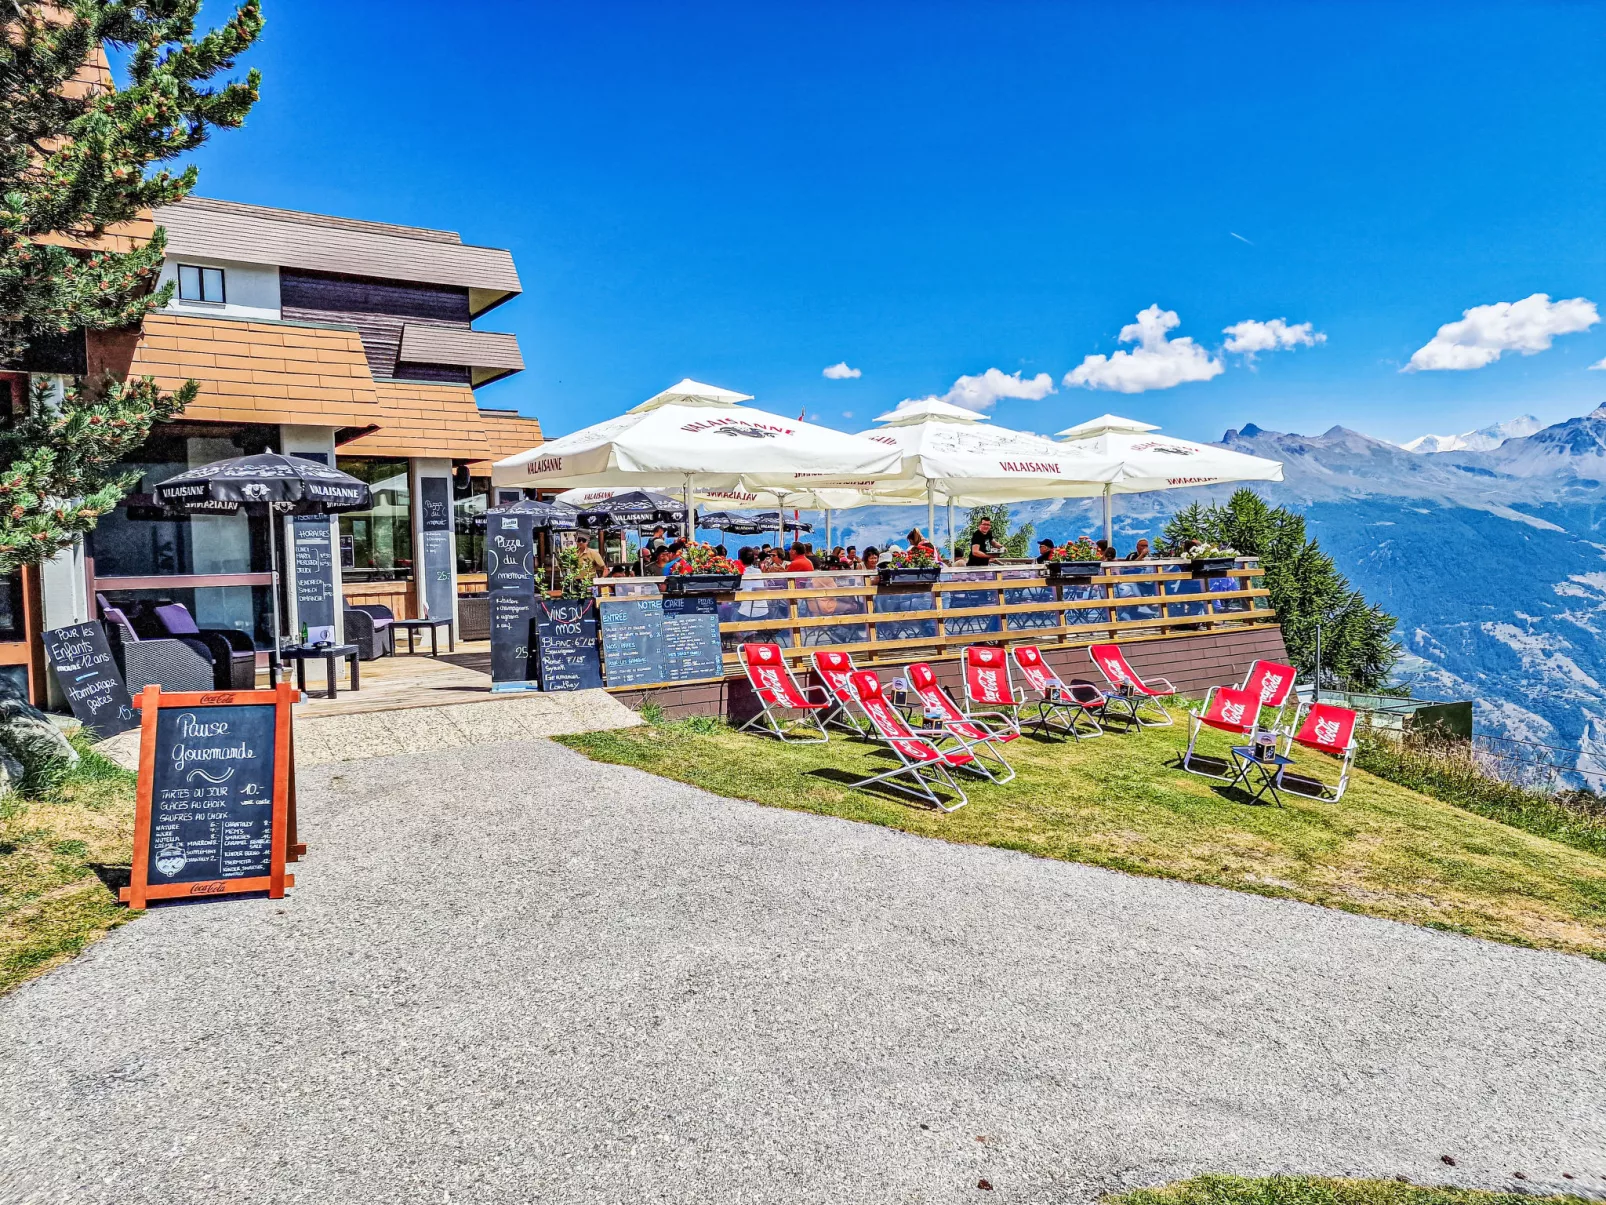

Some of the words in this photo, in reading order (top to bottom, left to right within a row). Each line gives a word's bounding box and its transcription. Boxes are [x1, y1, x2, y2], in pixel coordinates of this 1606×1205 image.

[680, 417, 796, 437] VALAISANNE
[527, 457, 562, 475] VALAISANNE
[999, 461, 1061, 474] VALAISANNE
[163, 485, 204, 498] VALAISANNE
[309, 484, 360, 498] VALAISANNE
[584, 491, 615, 501] VALAISANNE
[615, 513, 654, 522] VALAISANNE
[299, 530, 330, 538] HORAIRES
[494, 535, 525, 553] Pizza
[503, 554, 519, 565] du
[638, 600, 662, 610] NOTRE
[664, 598, 685, 608] CARTE
[52, 639, 93, 661] Enfants
[81, 655, 94, 668] 12
[200, 693, 235, 704] Coca-Cola
[177, 713, 231, 738] Pause
[160, 789, 190, 798] TARTES
[194, 788, 204, 797] DU
[206, 787, 228, 796] JOUR
[160, 801, 188, 810] GLACES
[191, 801, 201, 809] AU
[203, 798, 226, 808] CHOIX
[160, 813, 193, 822] GAUFRES
[195, 812, 205, 820] AU
[190, 882, 227, 895] Coca-Cola
